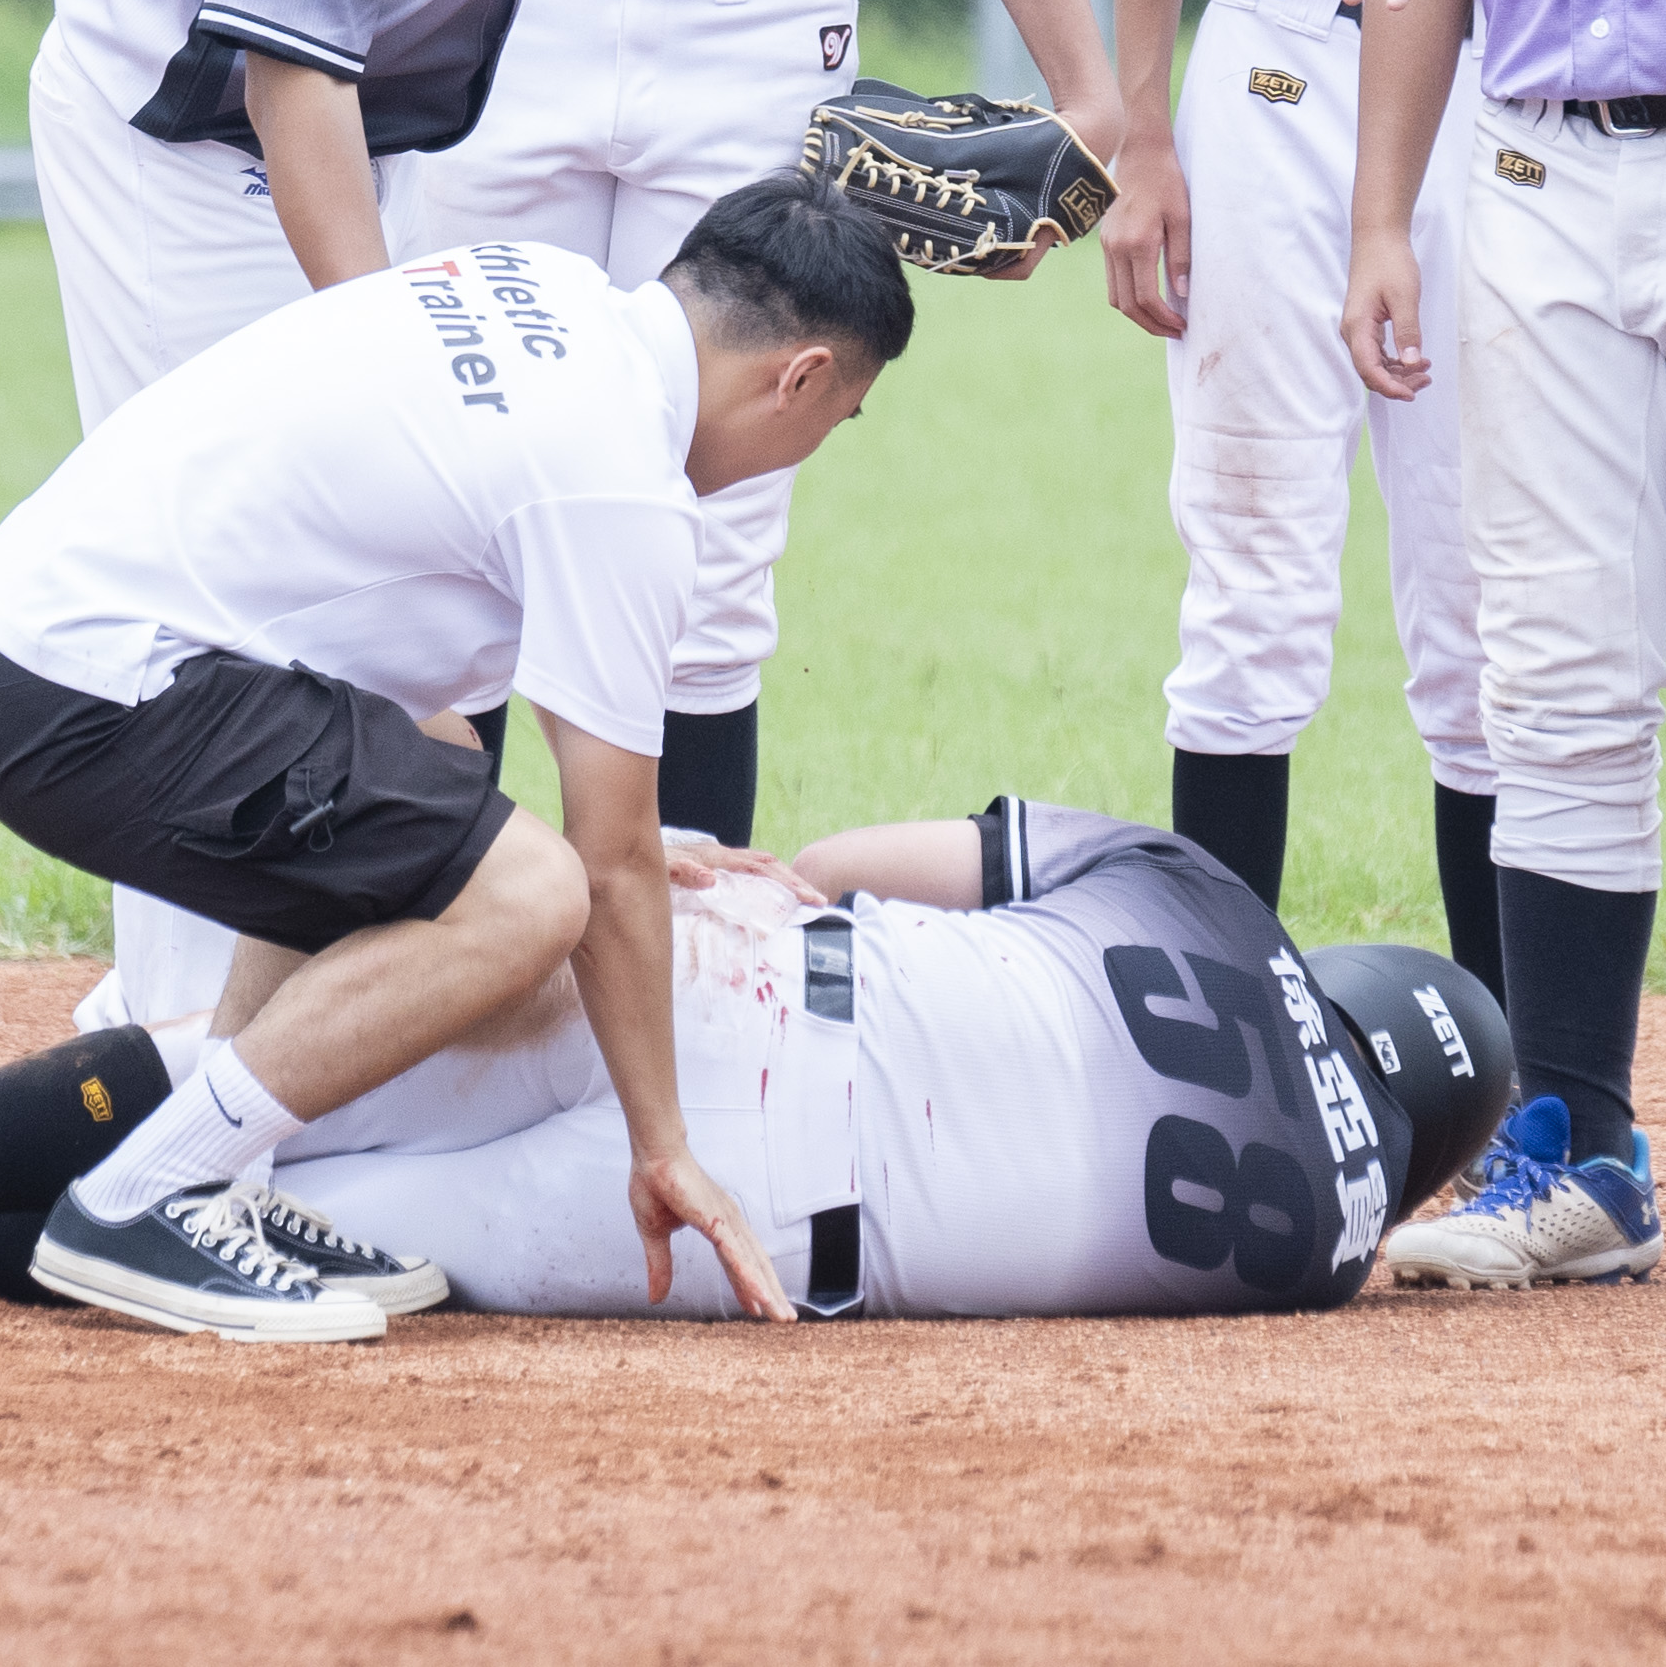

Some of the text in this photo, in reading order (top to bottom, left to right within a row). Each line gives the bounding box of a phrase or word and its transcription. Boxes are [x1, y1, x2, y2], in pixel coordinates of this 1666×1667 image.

[1254, 73, 1303, 95] ZETT
[1500, 154, 1543, 181] ZETT
[402, 260, 510, 415] Trainer
[470, 244, 569, 360] thletic
[1413, 984, 1475, 1078] ZETT
